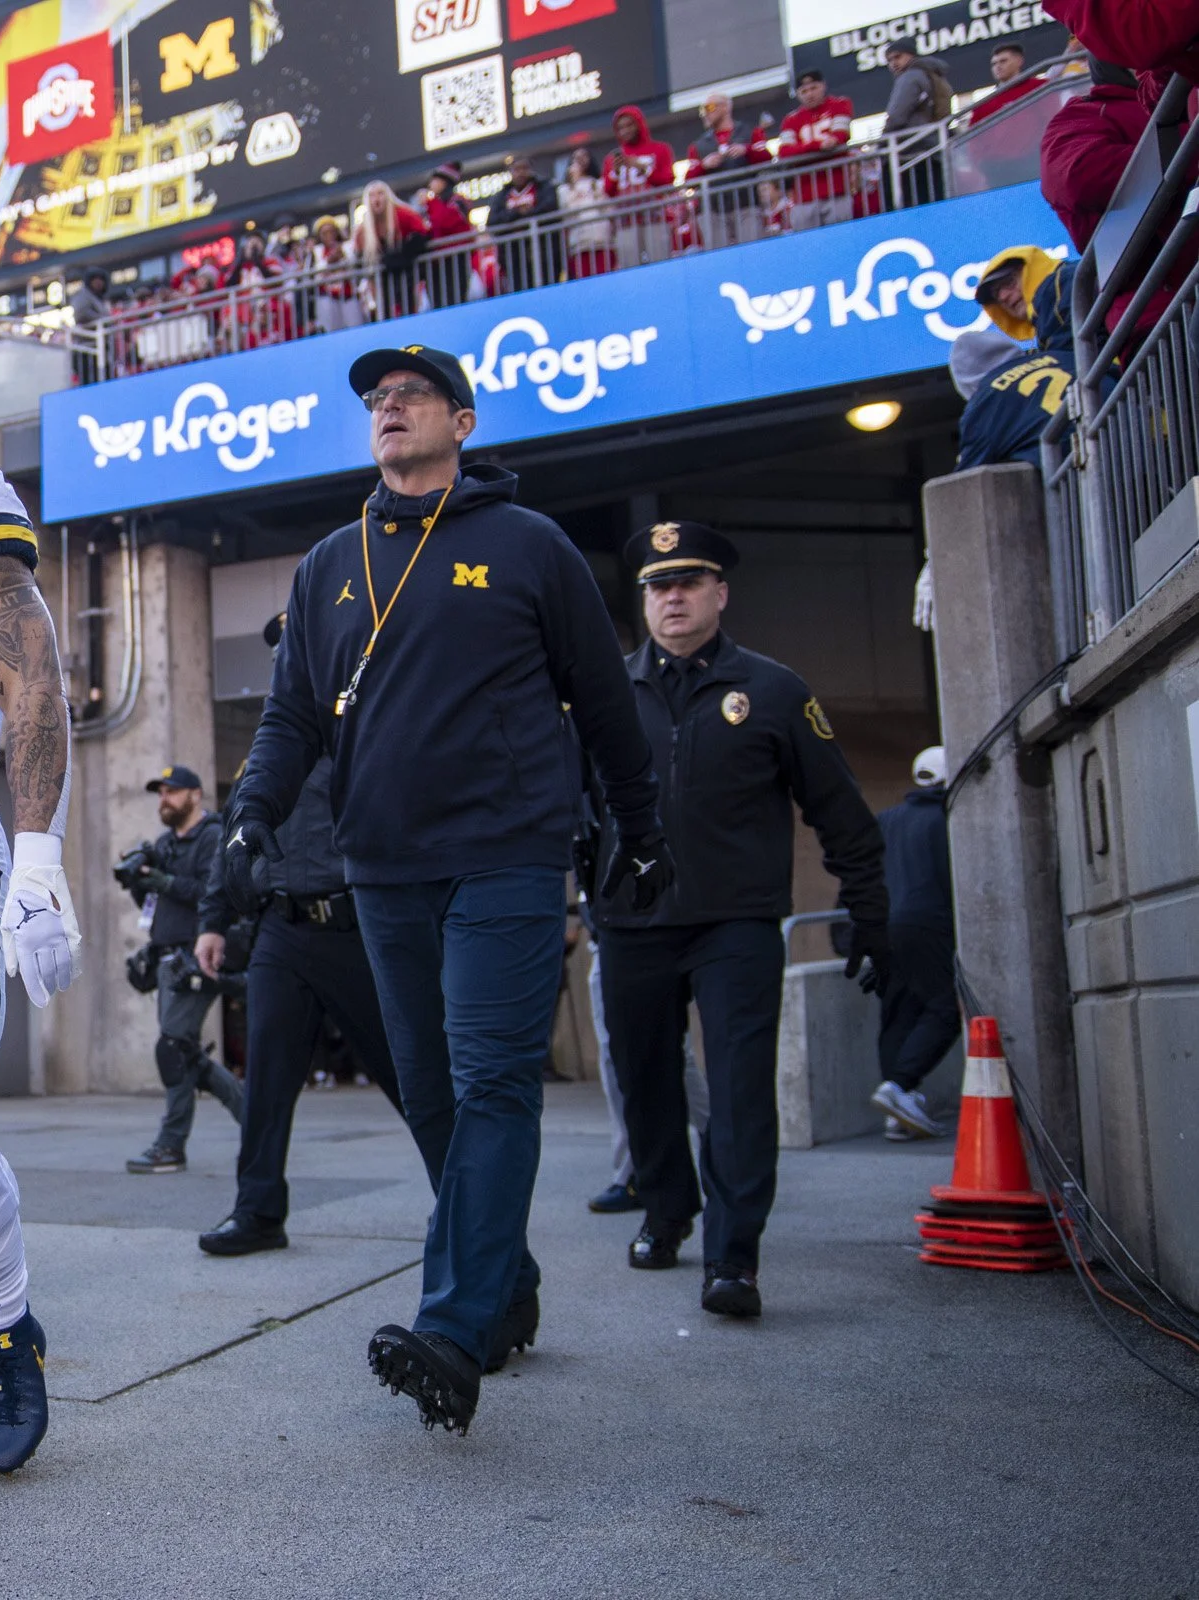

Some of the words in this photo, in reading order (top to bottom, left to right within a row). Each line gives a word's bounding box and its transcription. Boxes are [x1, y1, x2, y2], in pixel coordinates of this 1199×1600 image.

[159, 17, 238, 93] M
[829, 12, 930, 57] BLOCH
[856, 3, 1056, 71] SCUMAKER
[459, 317, 657, 413] Kroger
[991, 355, 1059, 391] CORUM
[153, 382, 319, 472] Kroger
[453, 562, 489, 588] M
